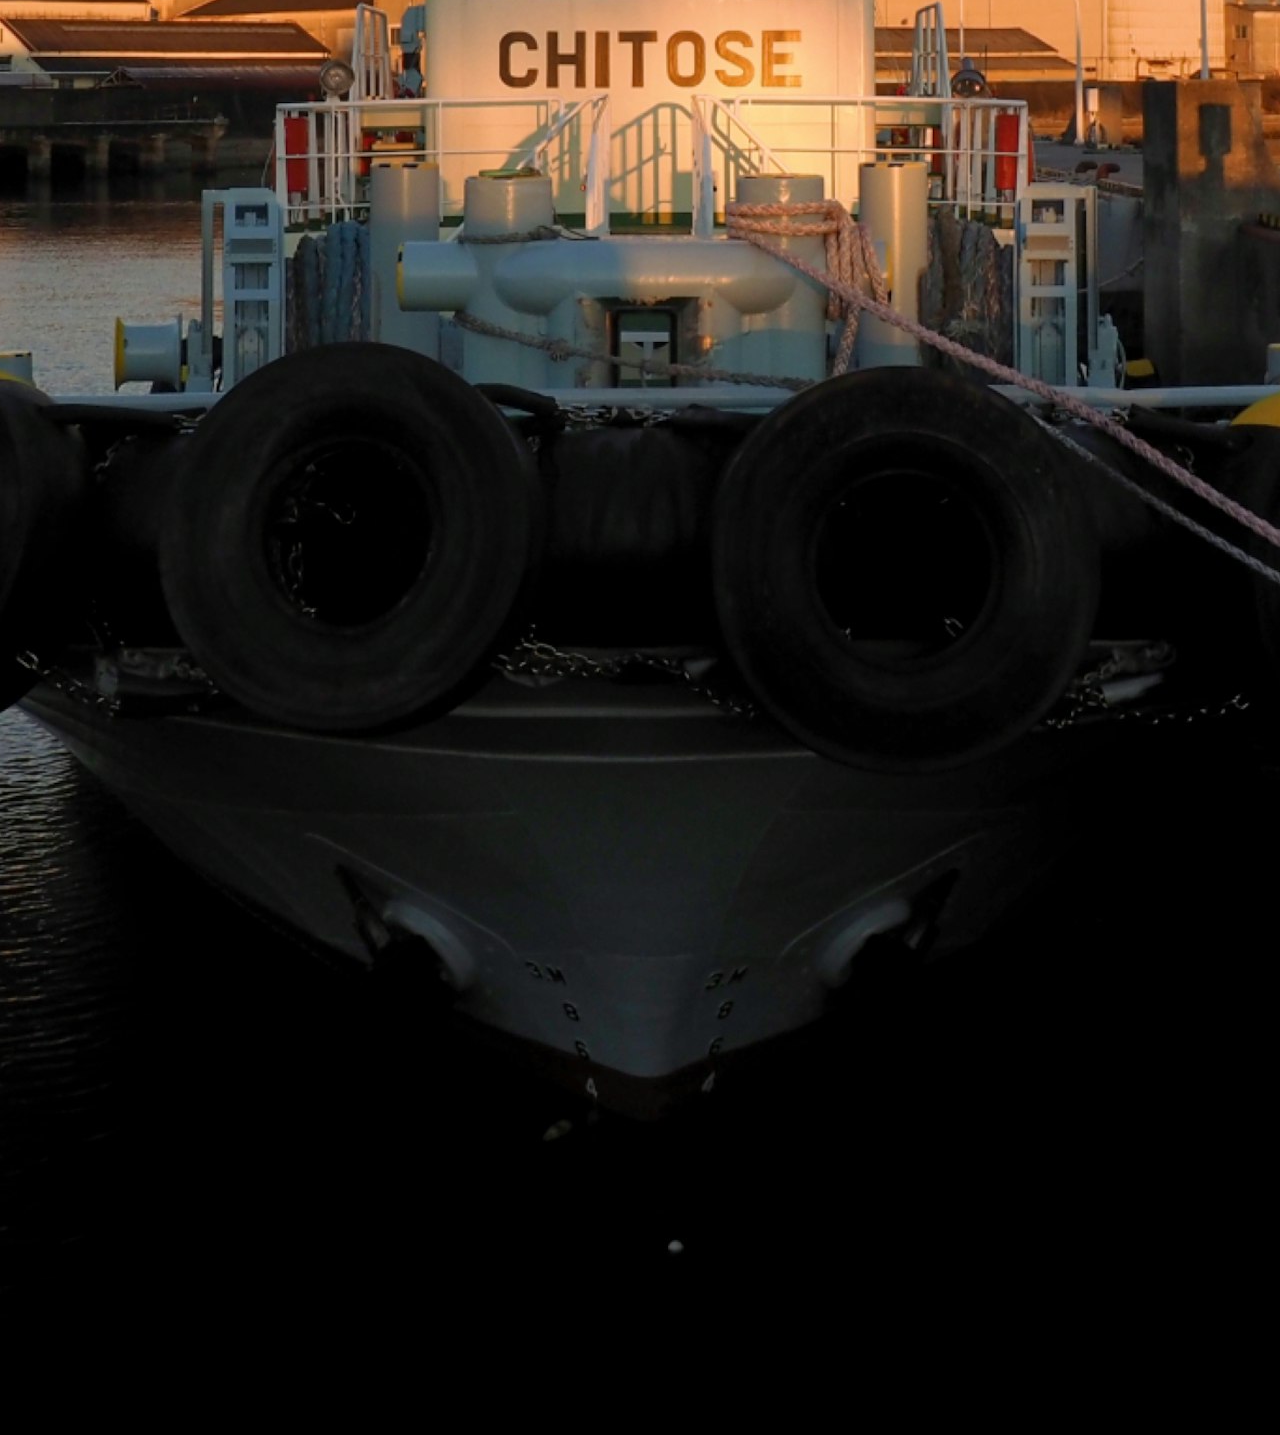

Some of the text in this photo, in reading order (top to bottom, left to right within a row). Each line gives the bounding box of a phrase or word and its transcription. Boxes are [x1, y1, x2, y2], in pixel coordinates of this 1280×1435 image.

[499, 30, 802, 88] CHITOSE
[563, 1002, 580, 1022] 8
[718, 1000, 734, 1020] 8
[575, 1040, 590, 1061] 6
